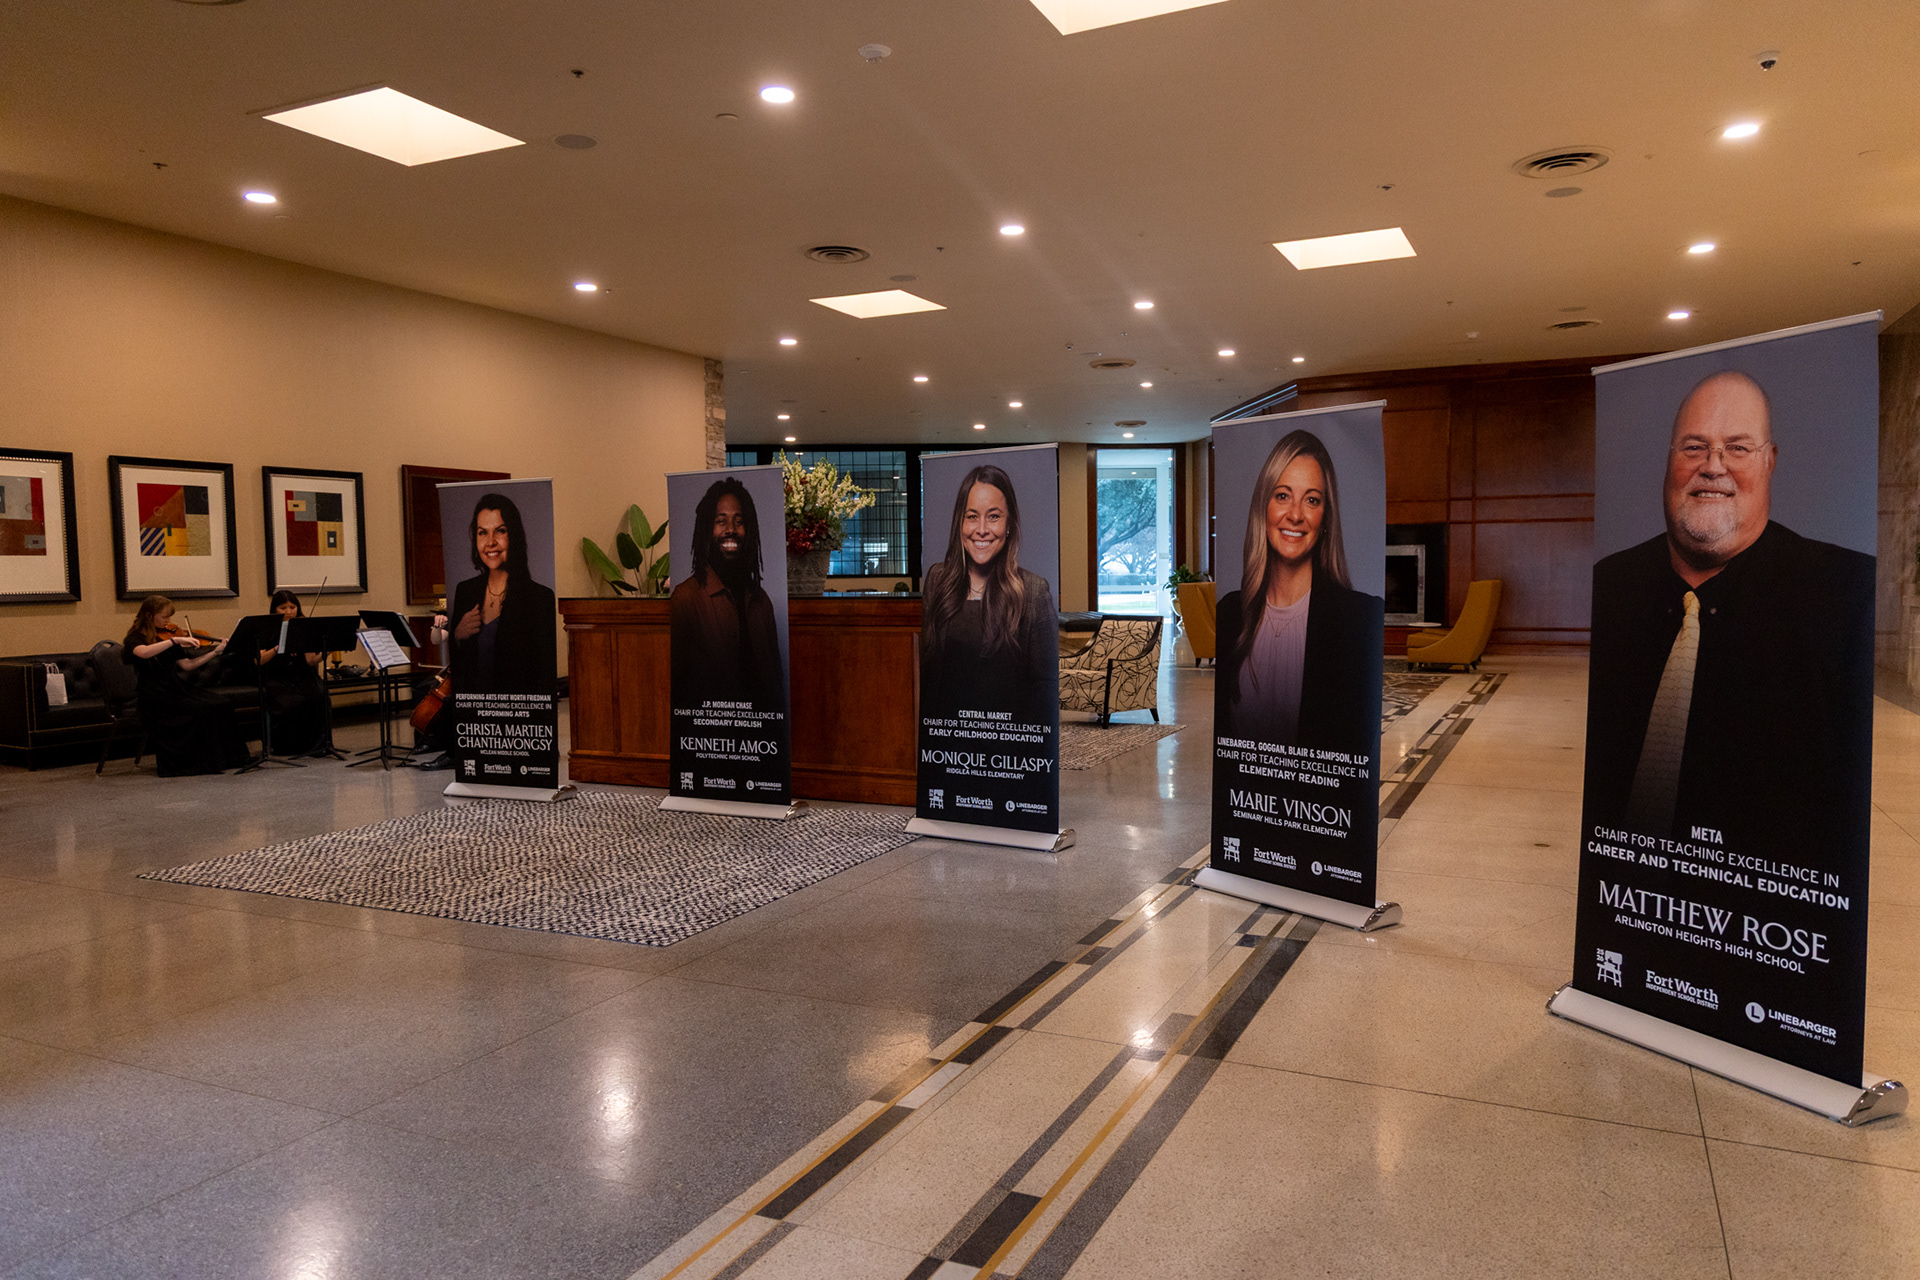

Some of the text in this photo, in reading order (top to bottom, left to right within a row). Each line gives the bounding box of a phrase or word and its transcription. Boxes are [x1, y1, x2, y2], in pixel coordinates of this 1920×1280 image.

[694, 718, 762, 728] SECONDARY ENGLISH
[737, 711, 775, 719] EXCELLENCE
[959, 710, 1012, 720] CENTRAL MARKET
[457, 723, 552, 737] CHRISTA MARTIEN
[923, 718, 942, 726] CHAIR
[944, 719, 958, 727] FOR
[959, 720, 994, 730] TEACHING
[996, 723, 1041, 733] EXCELLENCE
[929, 728, 1043, 743] EARLY CHILDHOOD EDUCATION
[458, 736, 552, 751] CHANTHAVONGSY
[680, 737, 778, 755] KENNETH AMOS
[1218, 737, 1369, 765] LINEBARGER, GOGGAN, BLAIR & SAMPSON, LLP
[922, 749, 1053, 773] MONIQUE GILLASPY
[1217, 748, 1368, 779] CHAIR FOR TEACHING EXCELLENCE IN
[946, 767, 969, 775] RIDGLEA
[988, 771, 1024, 779] ELEMENTARY
[1239, 763, 1340, 788] ELEMENTARY READING
[971, 797, 992, 805] Worth
[1016, 802, 1047, 810] LINEBARGER
[1230, 789, 1351, 828] MARIE VINSON
[1233, 810, 1347, 838] SEMINARY HILLS PARK ELEMENTARY
[1692, 826, 1723, 844] META
[1254, 848, 1296, 865] Fort Worth
[1594, 826, 1839, 888] CHAIR FOR TEACHING EXCELLENCE IN
[1324, 864, 1362, 878] LINEBARGER
[1588, 842, 1849, 910] CAREER AND TECHNICAL EDUCATION
[1599, 880, 1829, 963] MATTHEW ROSE
[1615, 914, 1805, 974] ARLINGTON HEIGHTS HIGH SCHOOL
[1646, 970, 1718, 1003] Fort Worth
[1646, 983, 1718, 1010] INDEPENDENT SCHOOL DISTRICT
[1768, 1009, 1836, 1038] LINEBARGER
[1780, 1023, 1813, 1039] ATTORNEYS
[1822, 1036, 1836, 1046] LAW
